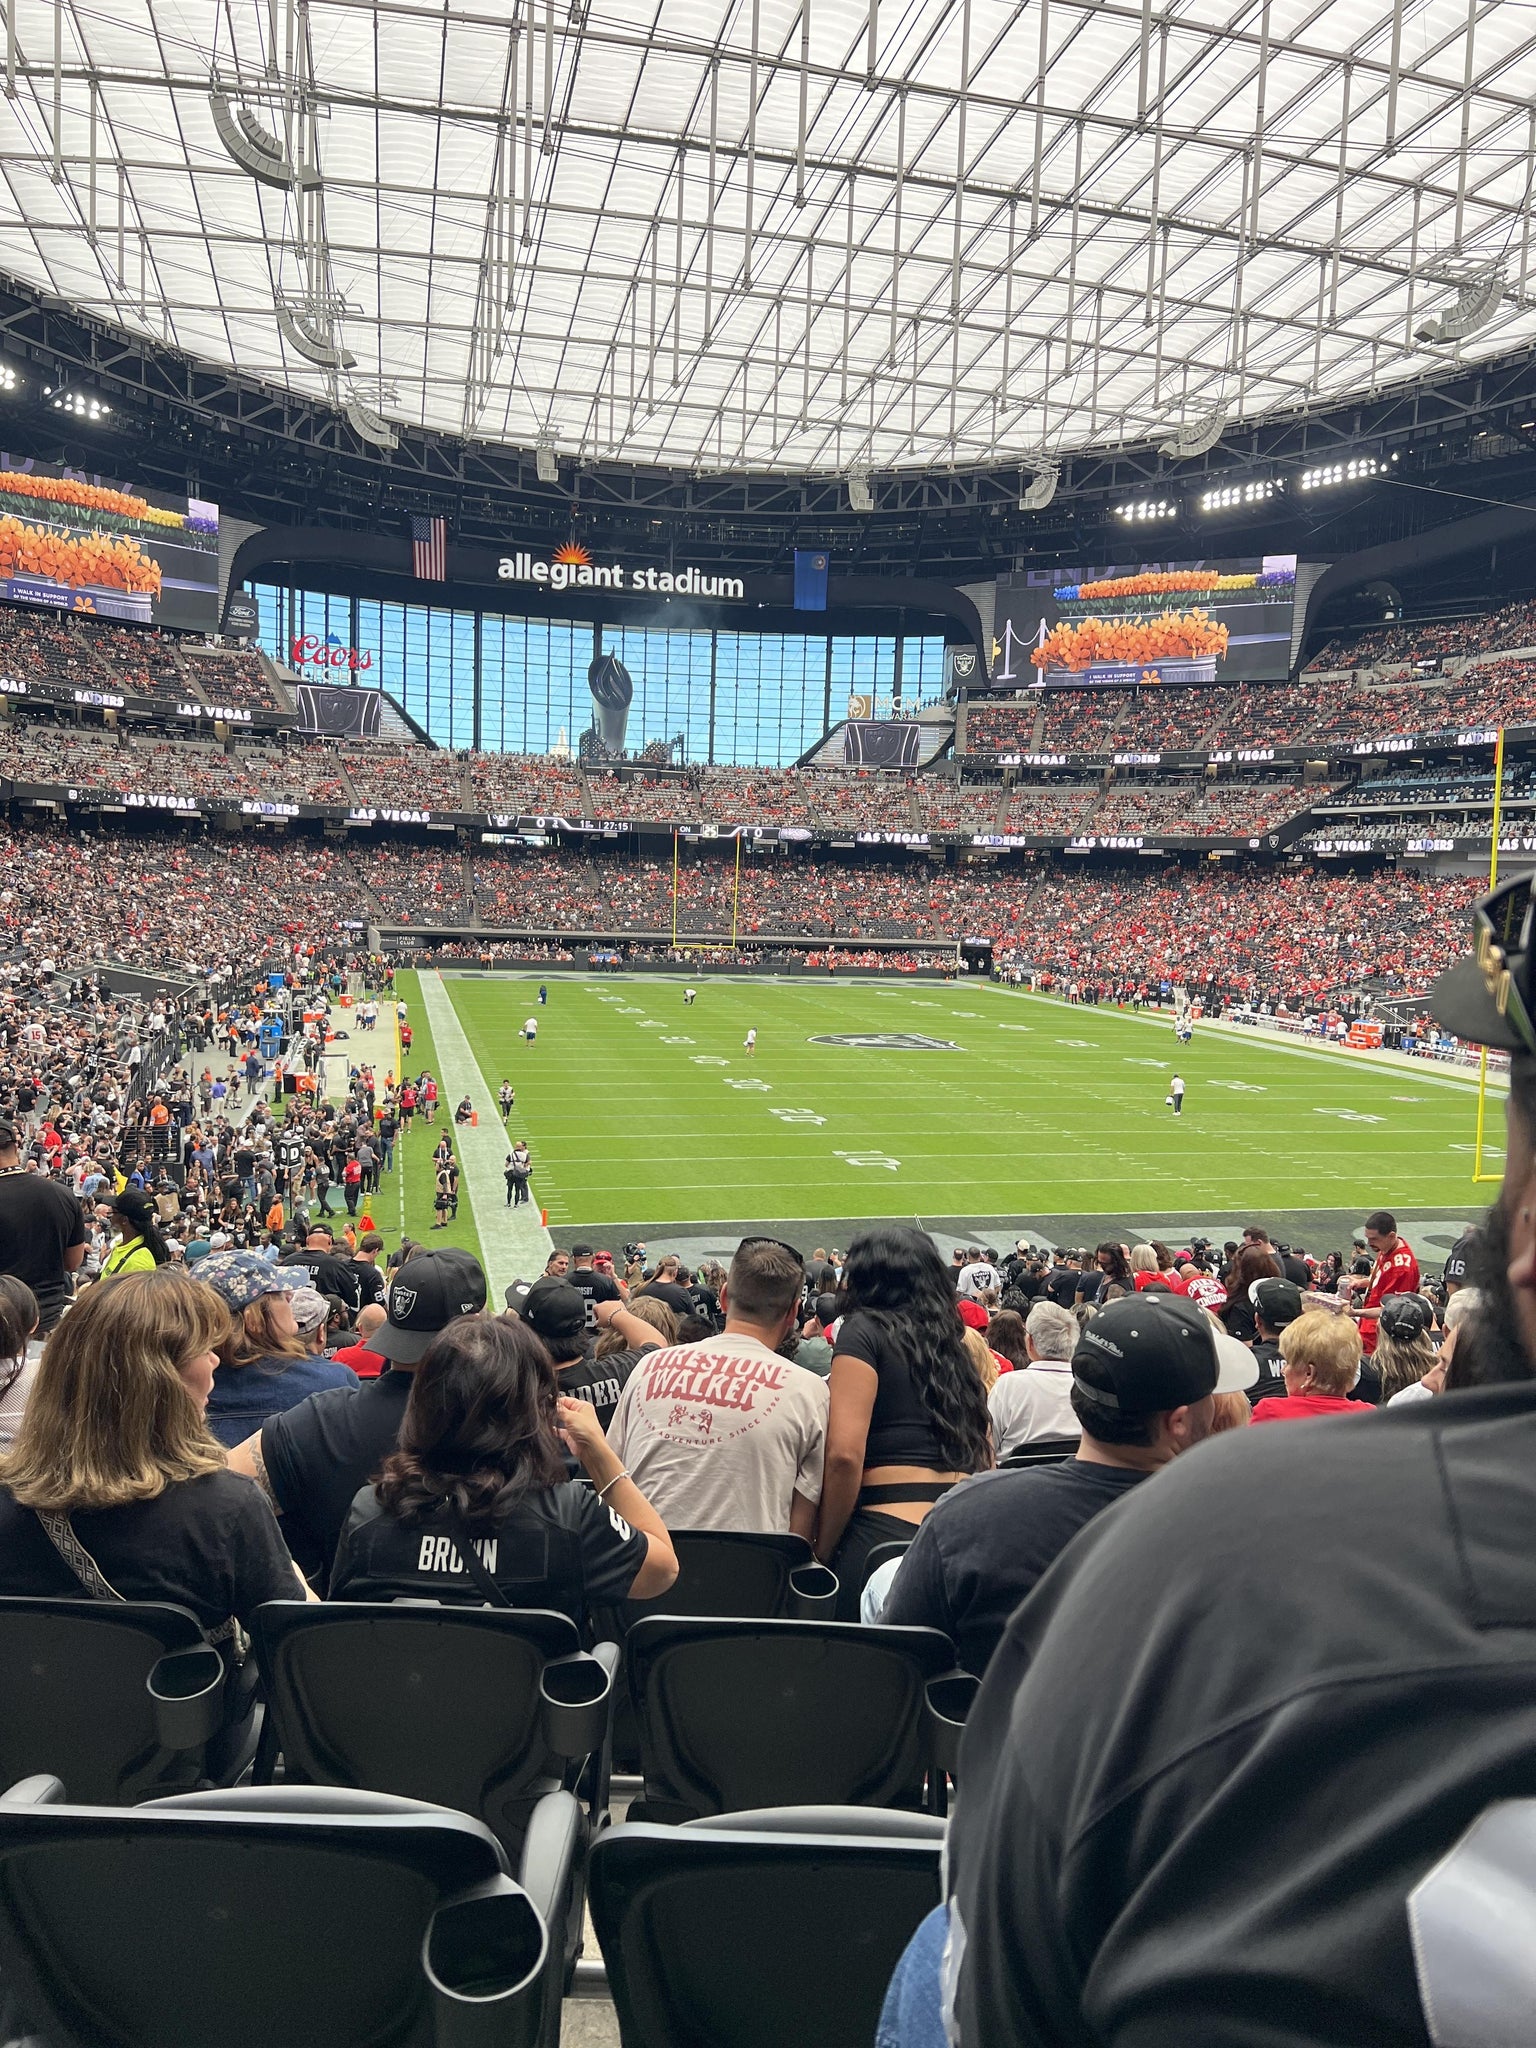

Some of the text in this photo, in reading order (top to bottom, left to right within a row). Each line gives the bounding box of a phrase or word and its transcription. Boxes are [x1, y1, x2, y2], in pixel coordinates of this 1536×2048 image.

[498, 552, 744, 598] allegiant stadium
[17, 588, 33, 596] WALK
[43, 592, 68, 602] SUPPORT
[291, 634, 374, 670] Coors
[301, 666, 365, 687] LIGHT
[75, 690, 125, 708] RAIDERS
[875, 695, 920, 712] MGM
[177, 703, 252, 721] LAS VEGAS
[1353, 738, 1413, 755] LAS VEGAS
[1457, 731, 1498, 747] RAIDER
[999, 755, 1066, 766] LAS VEGAS
[1114, 753, 1161, 765] RAIDERS
[1209, 749, 1275, 763] LAS VEGAS
[122, 792, 196, 810] LAS VEGAS
[242, 801, 300, 816] RAIDERS
[350, 807, 431, 823] LAS VEGAS
[536, 817, 546, 828] 0
[603, 821, 629, 831] 27:15
[754, 827, 763, 838] 0
[857, 832, 928, 844] LAS VEGAS
[973, 834, 1026, 846] RAIDERS
[1070, 837, 1144, 848] LAS VEGAS
[1313, 840, 1371, 852] LAS VEGAS
[1407, 840, 1453, 852] RAIDERS
[1497, 838, 1519, 850] LAS
[31, 1030, 41, 1040] 15
[291, 1147, 300, 1161] D
[832, 1150, 902, 1167] 10
[1393, 1254, 1412, 1268] 87
[1448, 1259, 1466, 1276] 16
[643, 1349, 792, 1391] FIRESTONE
[646, 1368, 762, 1412] WALKER
[658, 1430, 722, 1446] ADVENTURE
[729, 1418, 761, 1439] SINCE
